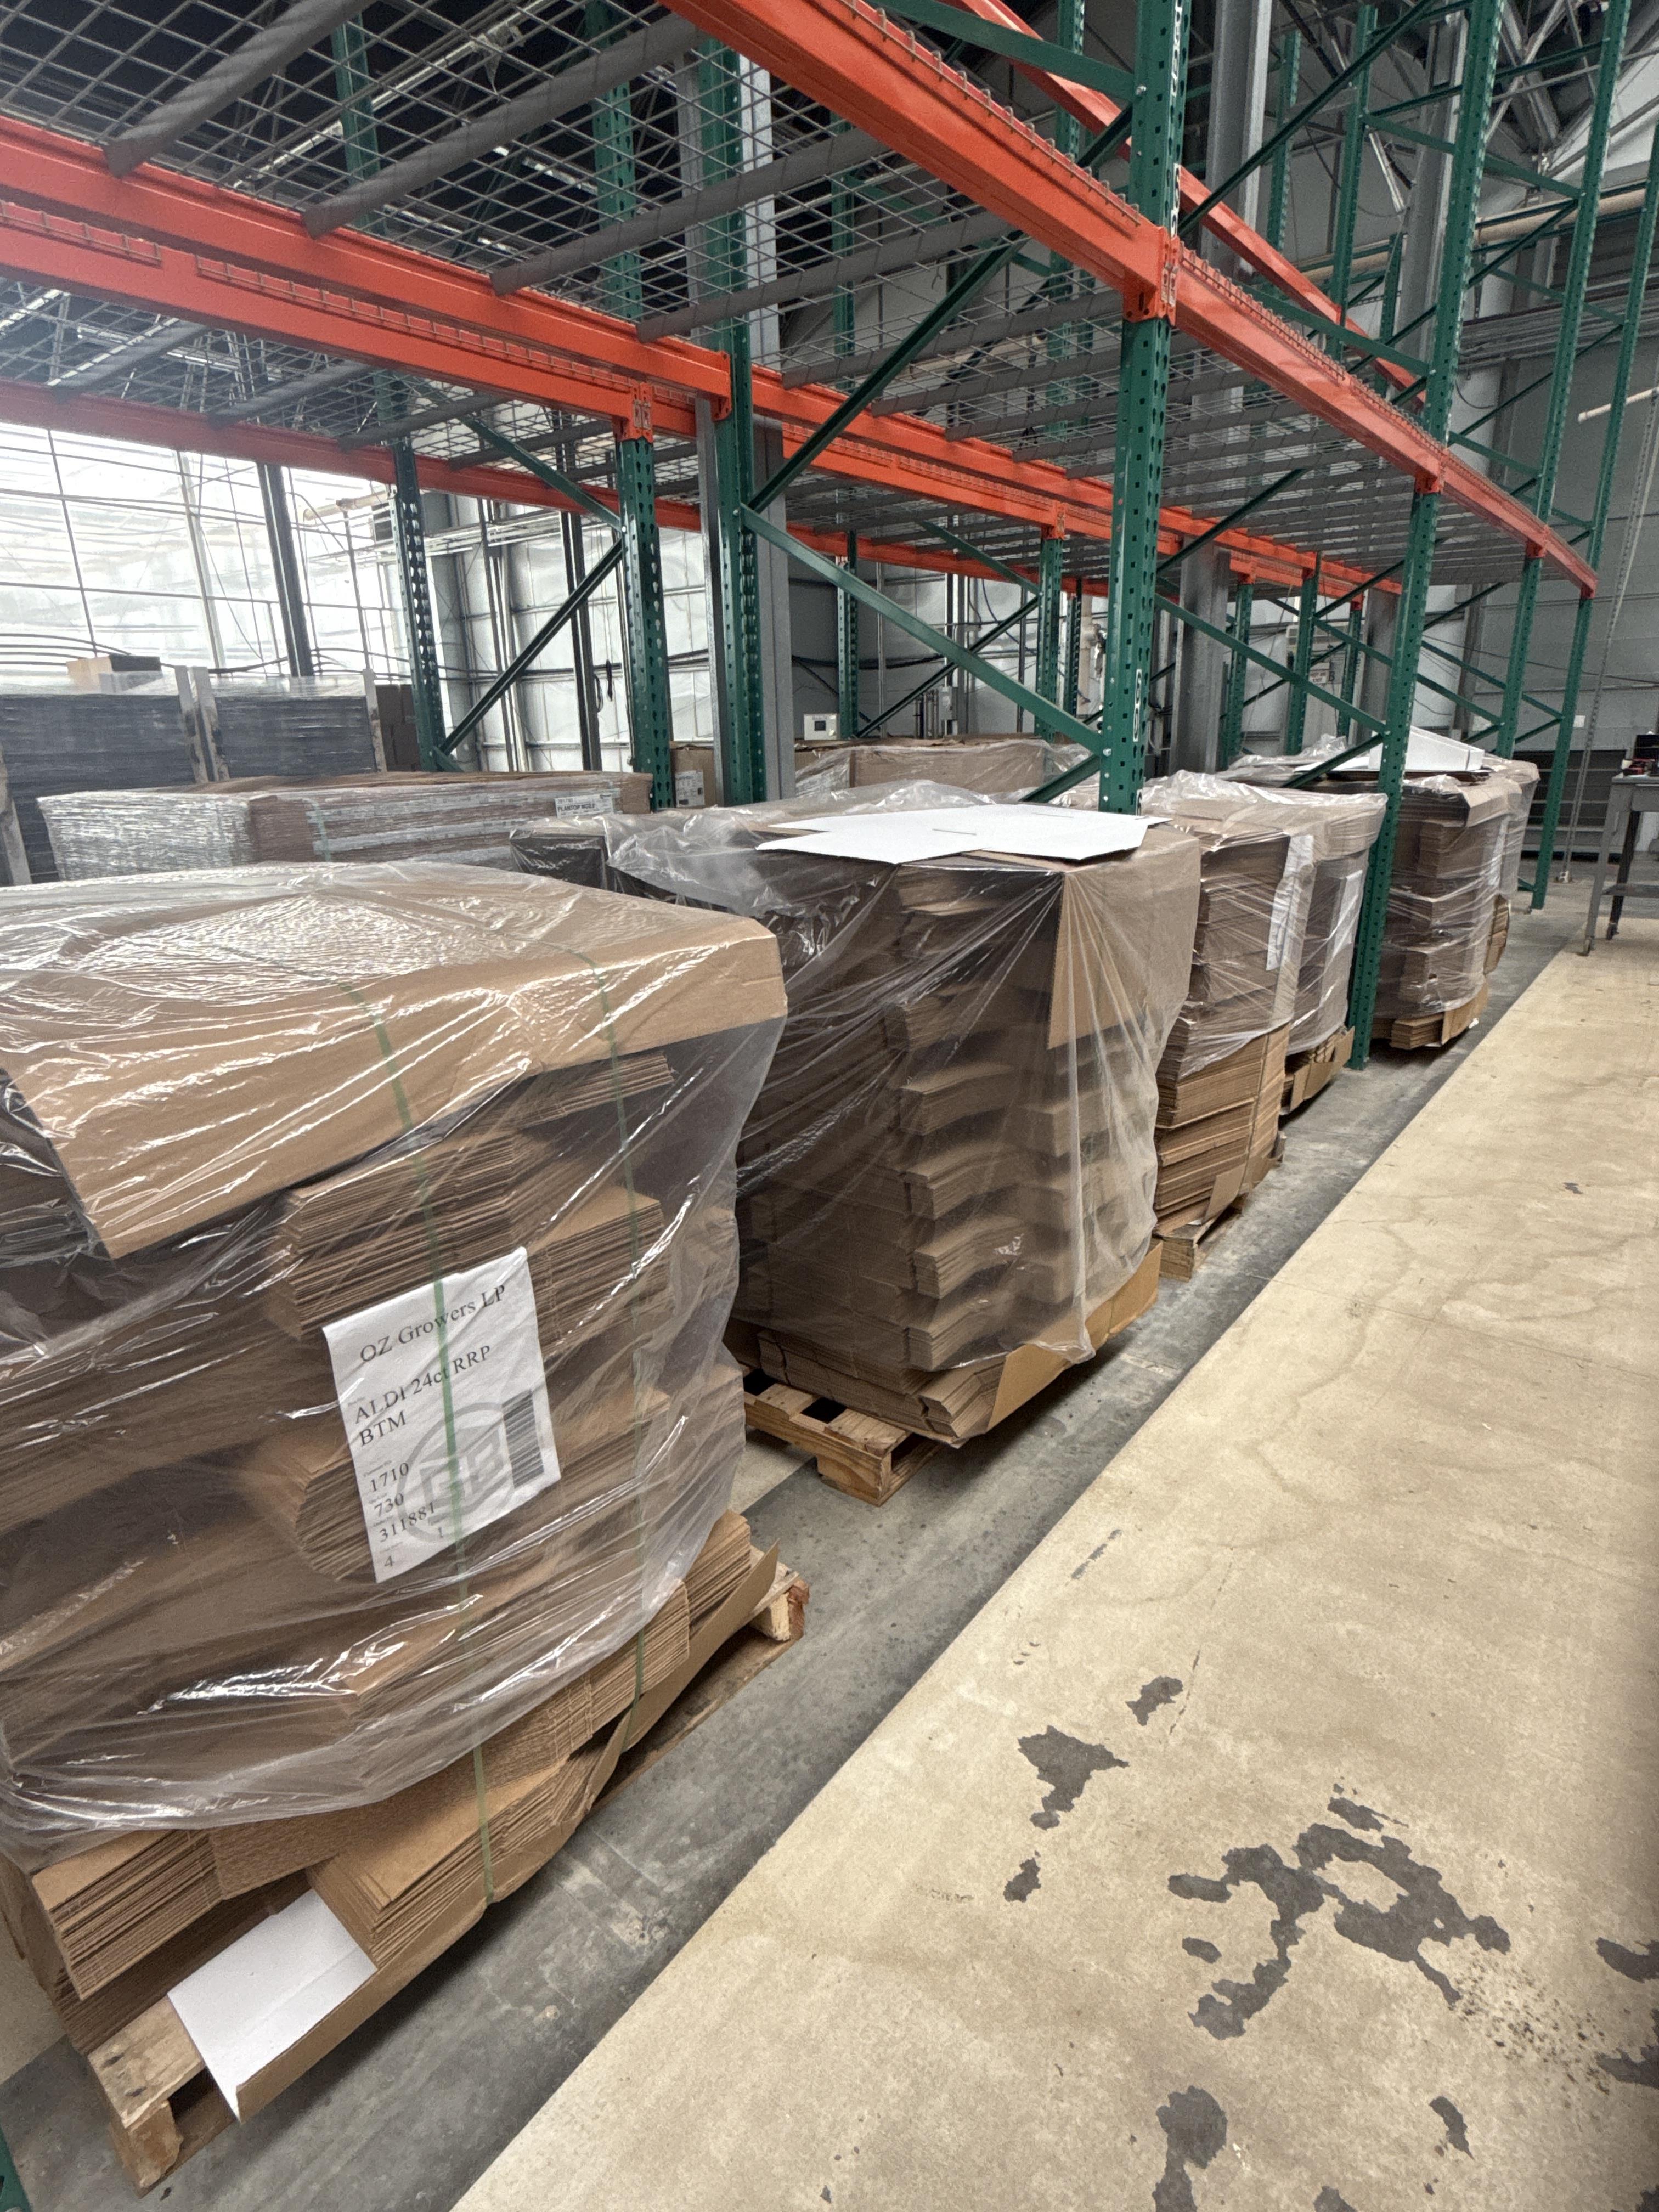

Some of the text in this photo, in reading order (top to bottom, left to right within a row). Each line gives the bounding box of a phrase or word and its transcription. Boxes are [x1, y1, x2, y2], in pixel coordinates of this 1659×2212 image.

[360, 1285, 505, 1362] OZ Growers LP
[355, 1386, 407, 1424] ALDI
[453, 1346, 490, 1374] RRP
[359, 1410, 406, 1446] BTM
[371, 1463, 409, 1492] 1710
[374, 1493, 404, 1518] 730
[379, 1502, 435, 1543] 311881
[384, 1555, 394, 1567] 4
